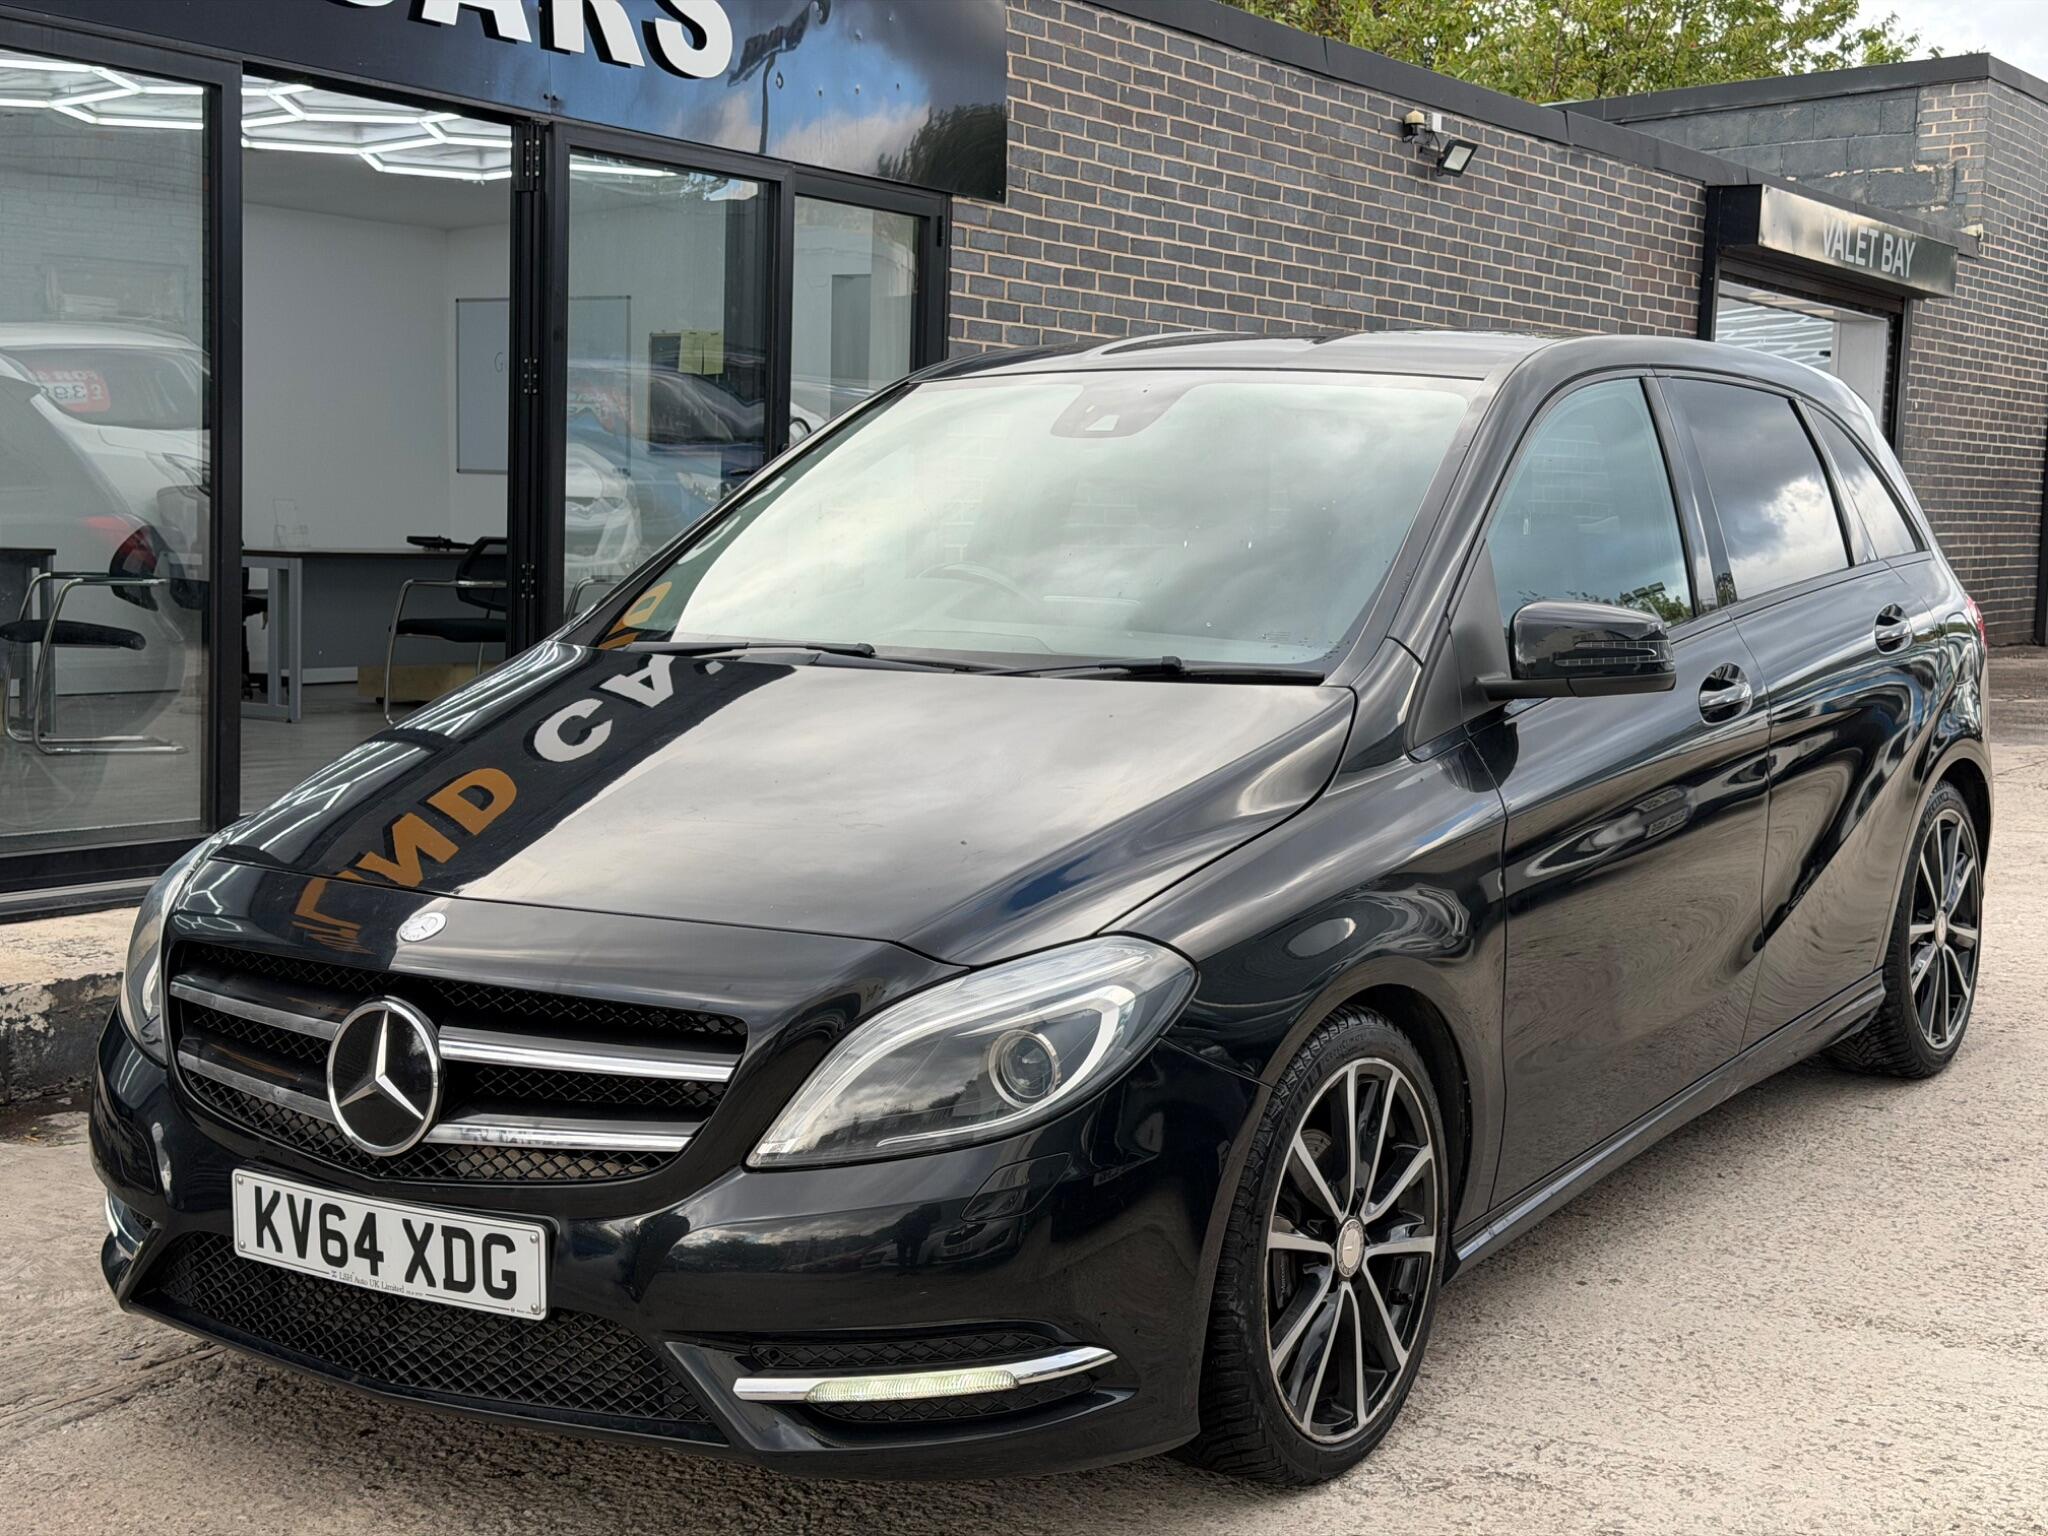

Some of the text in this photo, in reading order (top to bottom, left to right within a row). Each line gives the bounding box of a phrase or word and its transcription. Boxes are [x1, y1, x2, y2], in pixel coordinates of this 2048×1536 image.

[1823, 217, 1916, 278] VALET BAY
[254, 1185, 517, 1301] KV64 XDG
[369, 1278, 380, 1288] UK
[381, 1281, 405, 1293] Limited
